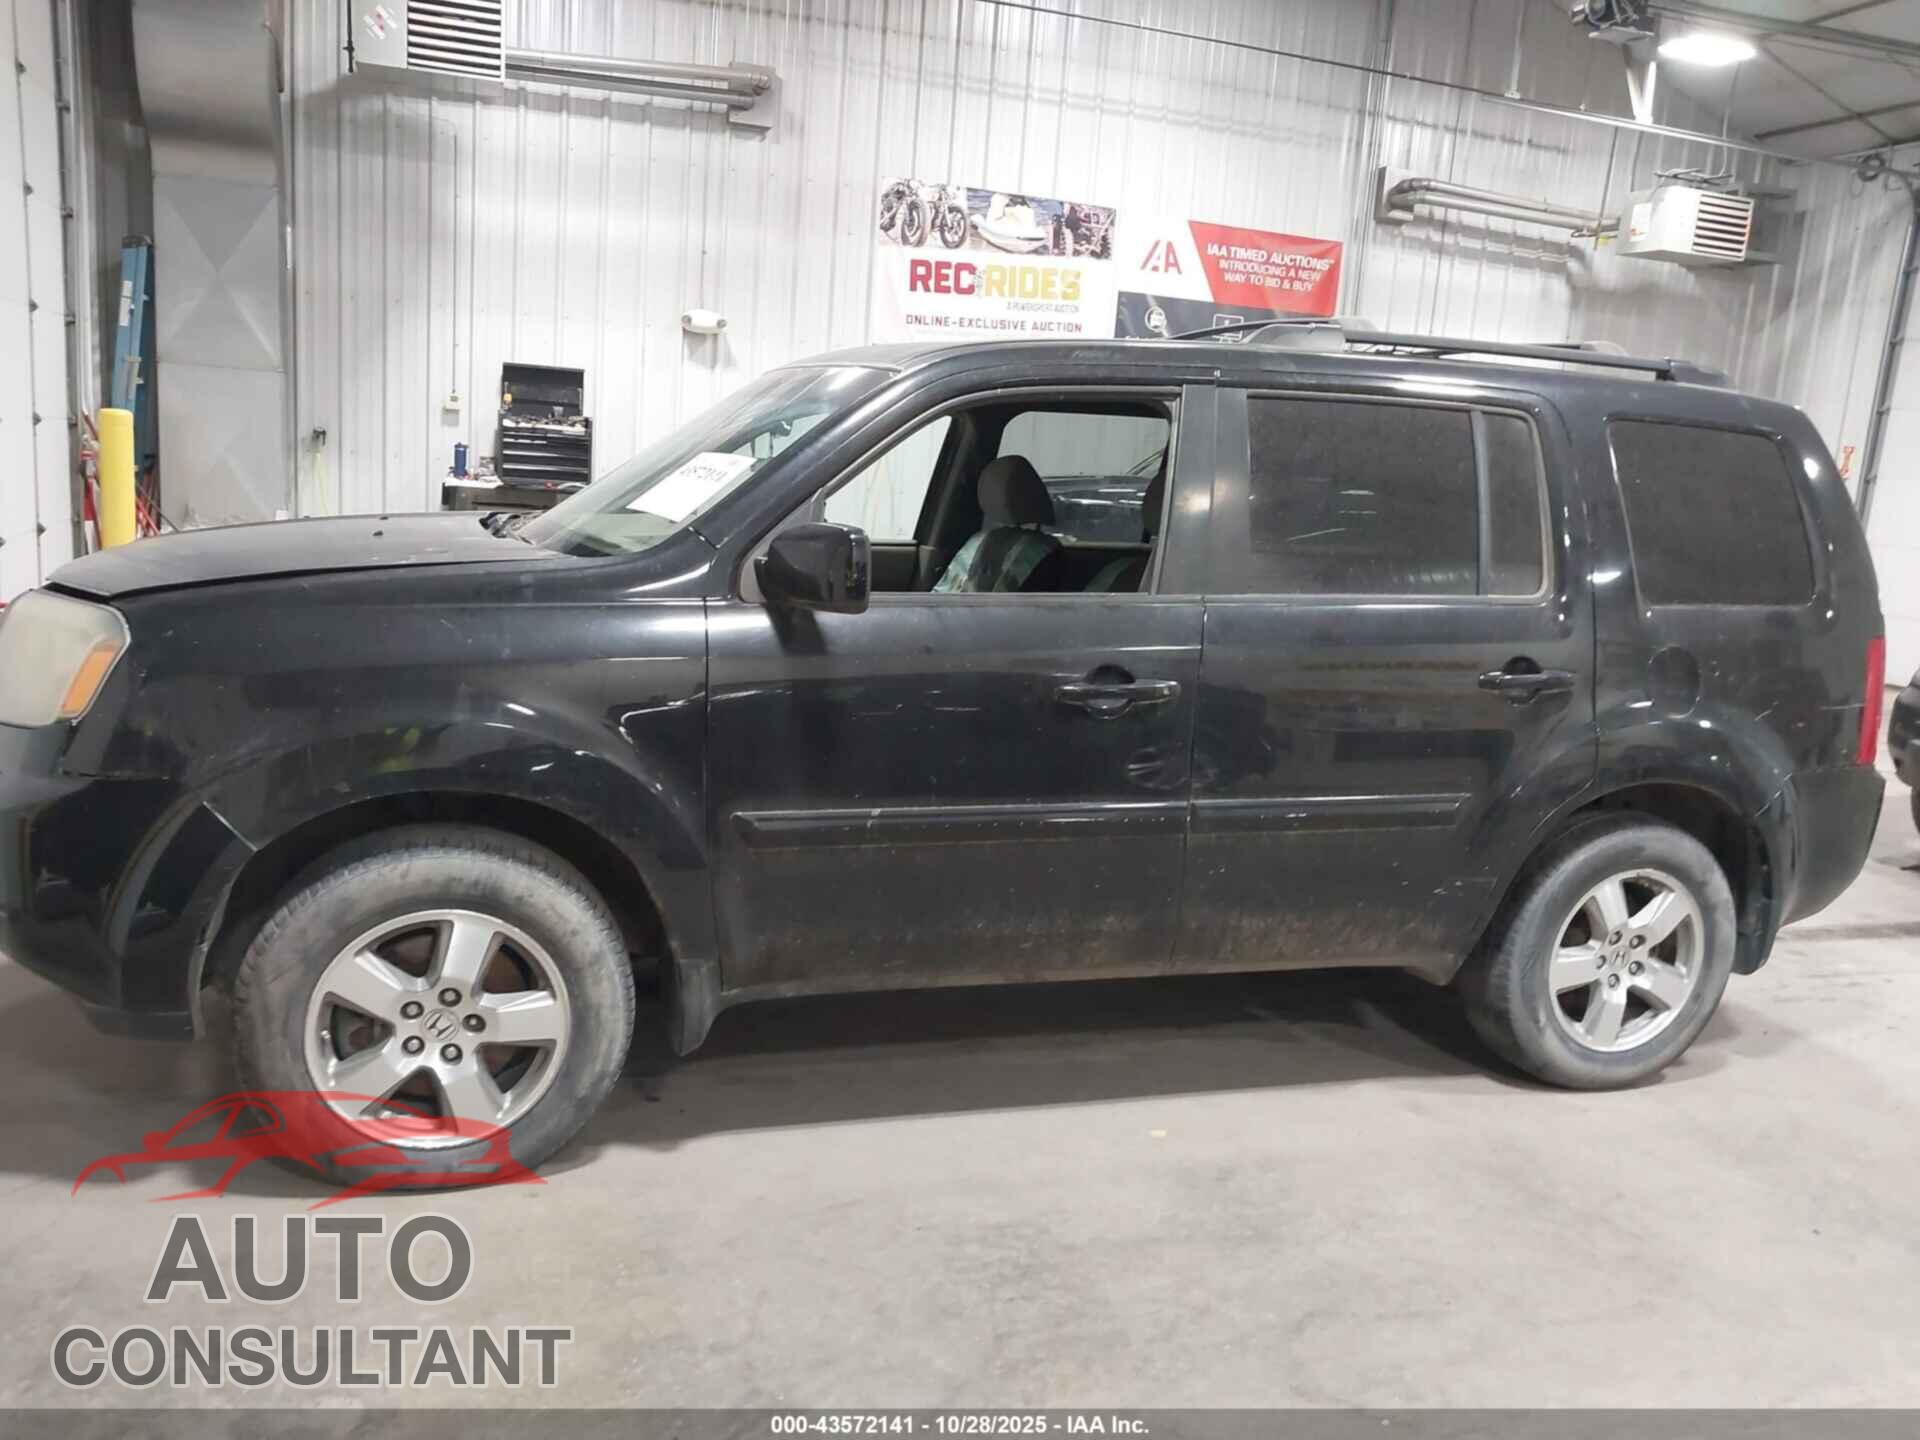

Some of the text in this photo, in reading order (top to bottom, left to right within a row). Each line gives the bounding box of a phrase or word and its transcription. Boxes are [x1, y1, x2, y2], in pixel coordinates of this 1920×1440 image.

[1229, 246, 1267, 263] TIMED
[909, 259, 976, 295] REC
[984, 264, 1082, 301] RIDES
[1219, 259, 1322, 282] INTRODUCING A NEW
[1224, 271, 1247, 284] WAY
[1248, 273, 1264, 286] TO
[1264, 276, 1281, 288] BID
[1292, 279, 1313, 292] BUY
[905, 313, 1082, 333] ONLINE-EXCLUSIVE AUCTION
